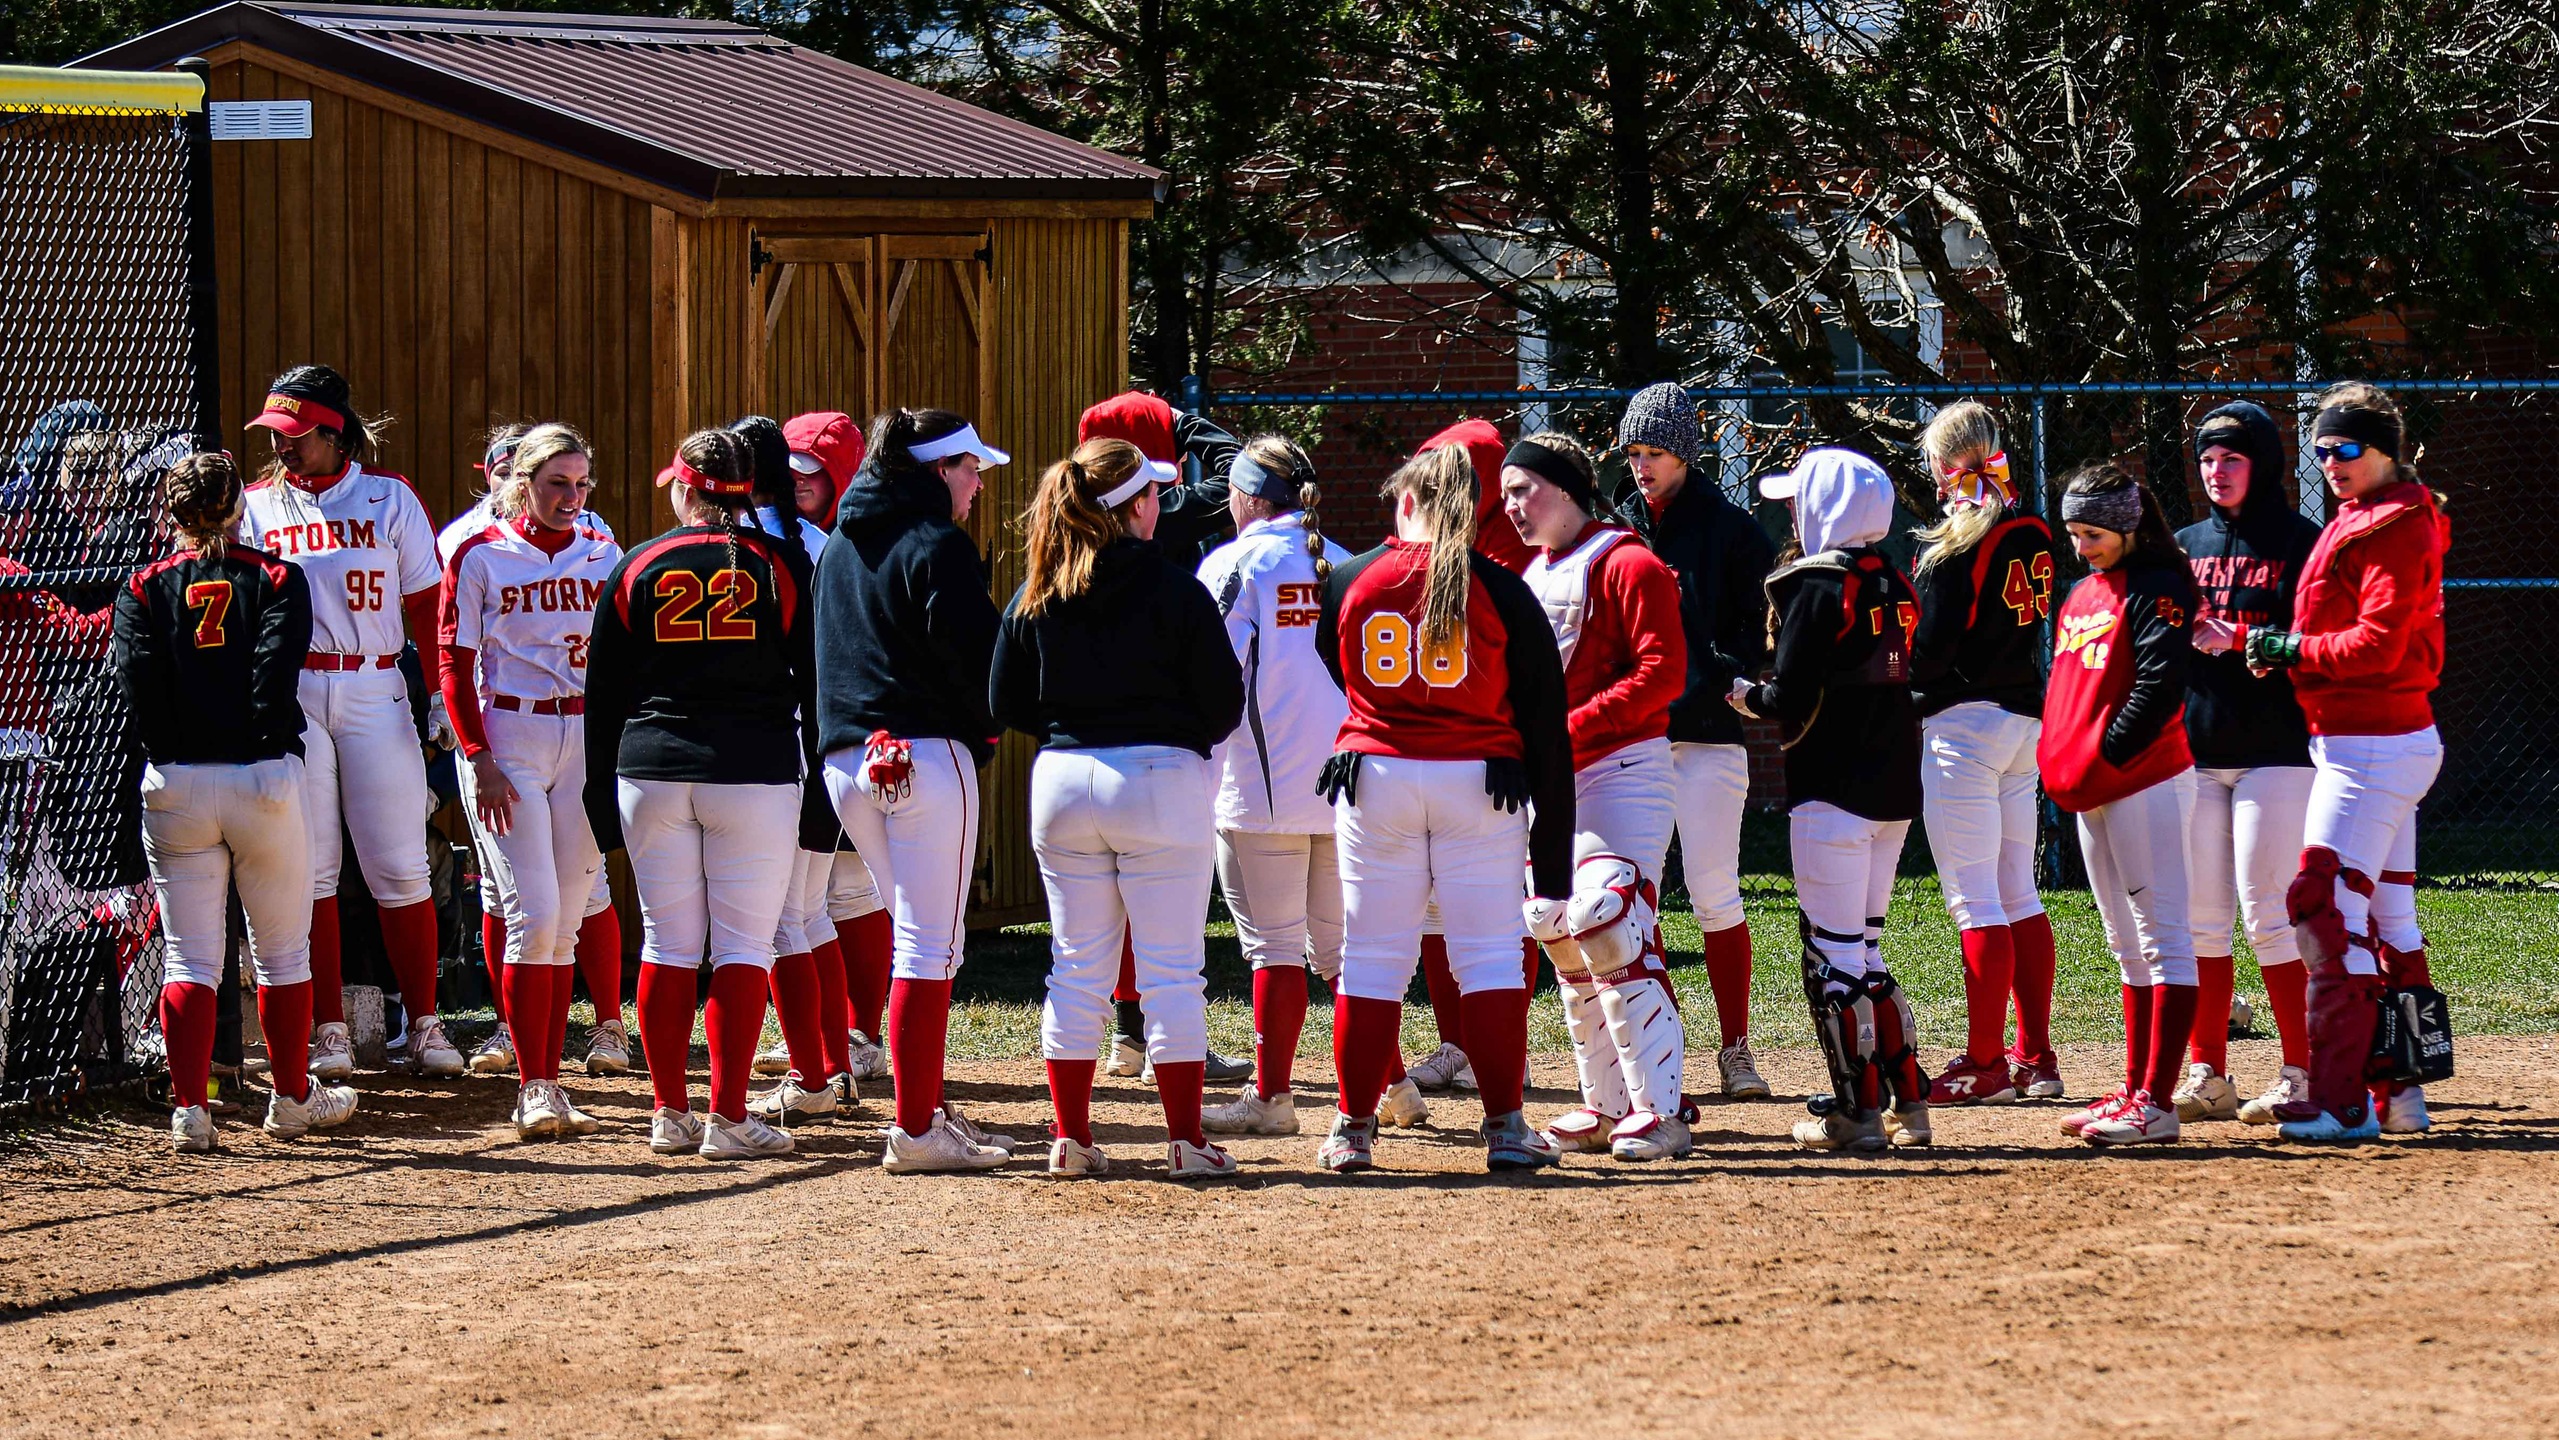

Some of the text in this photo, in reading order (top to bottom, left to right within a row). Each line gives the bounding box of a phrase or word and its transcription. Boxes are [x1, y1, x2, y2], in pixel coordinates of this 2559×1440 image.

[726, 484, 744, 492] STORM
[264, 518, 377, 559] STORM
[345, 569, 385, 612] 95
[2002, 551, 2055, 626] 43
[2189, 556, 2287, 591] VERYDAY
[185, 580, 232, 649] 7
[500, 577, 609, 615] STORM
[654, 569, 757, 642] 22
[1869, 600, 1919, 653] 7
[563, 633, 593, 669] 2
[1361, 611, 1468, 688] 88
